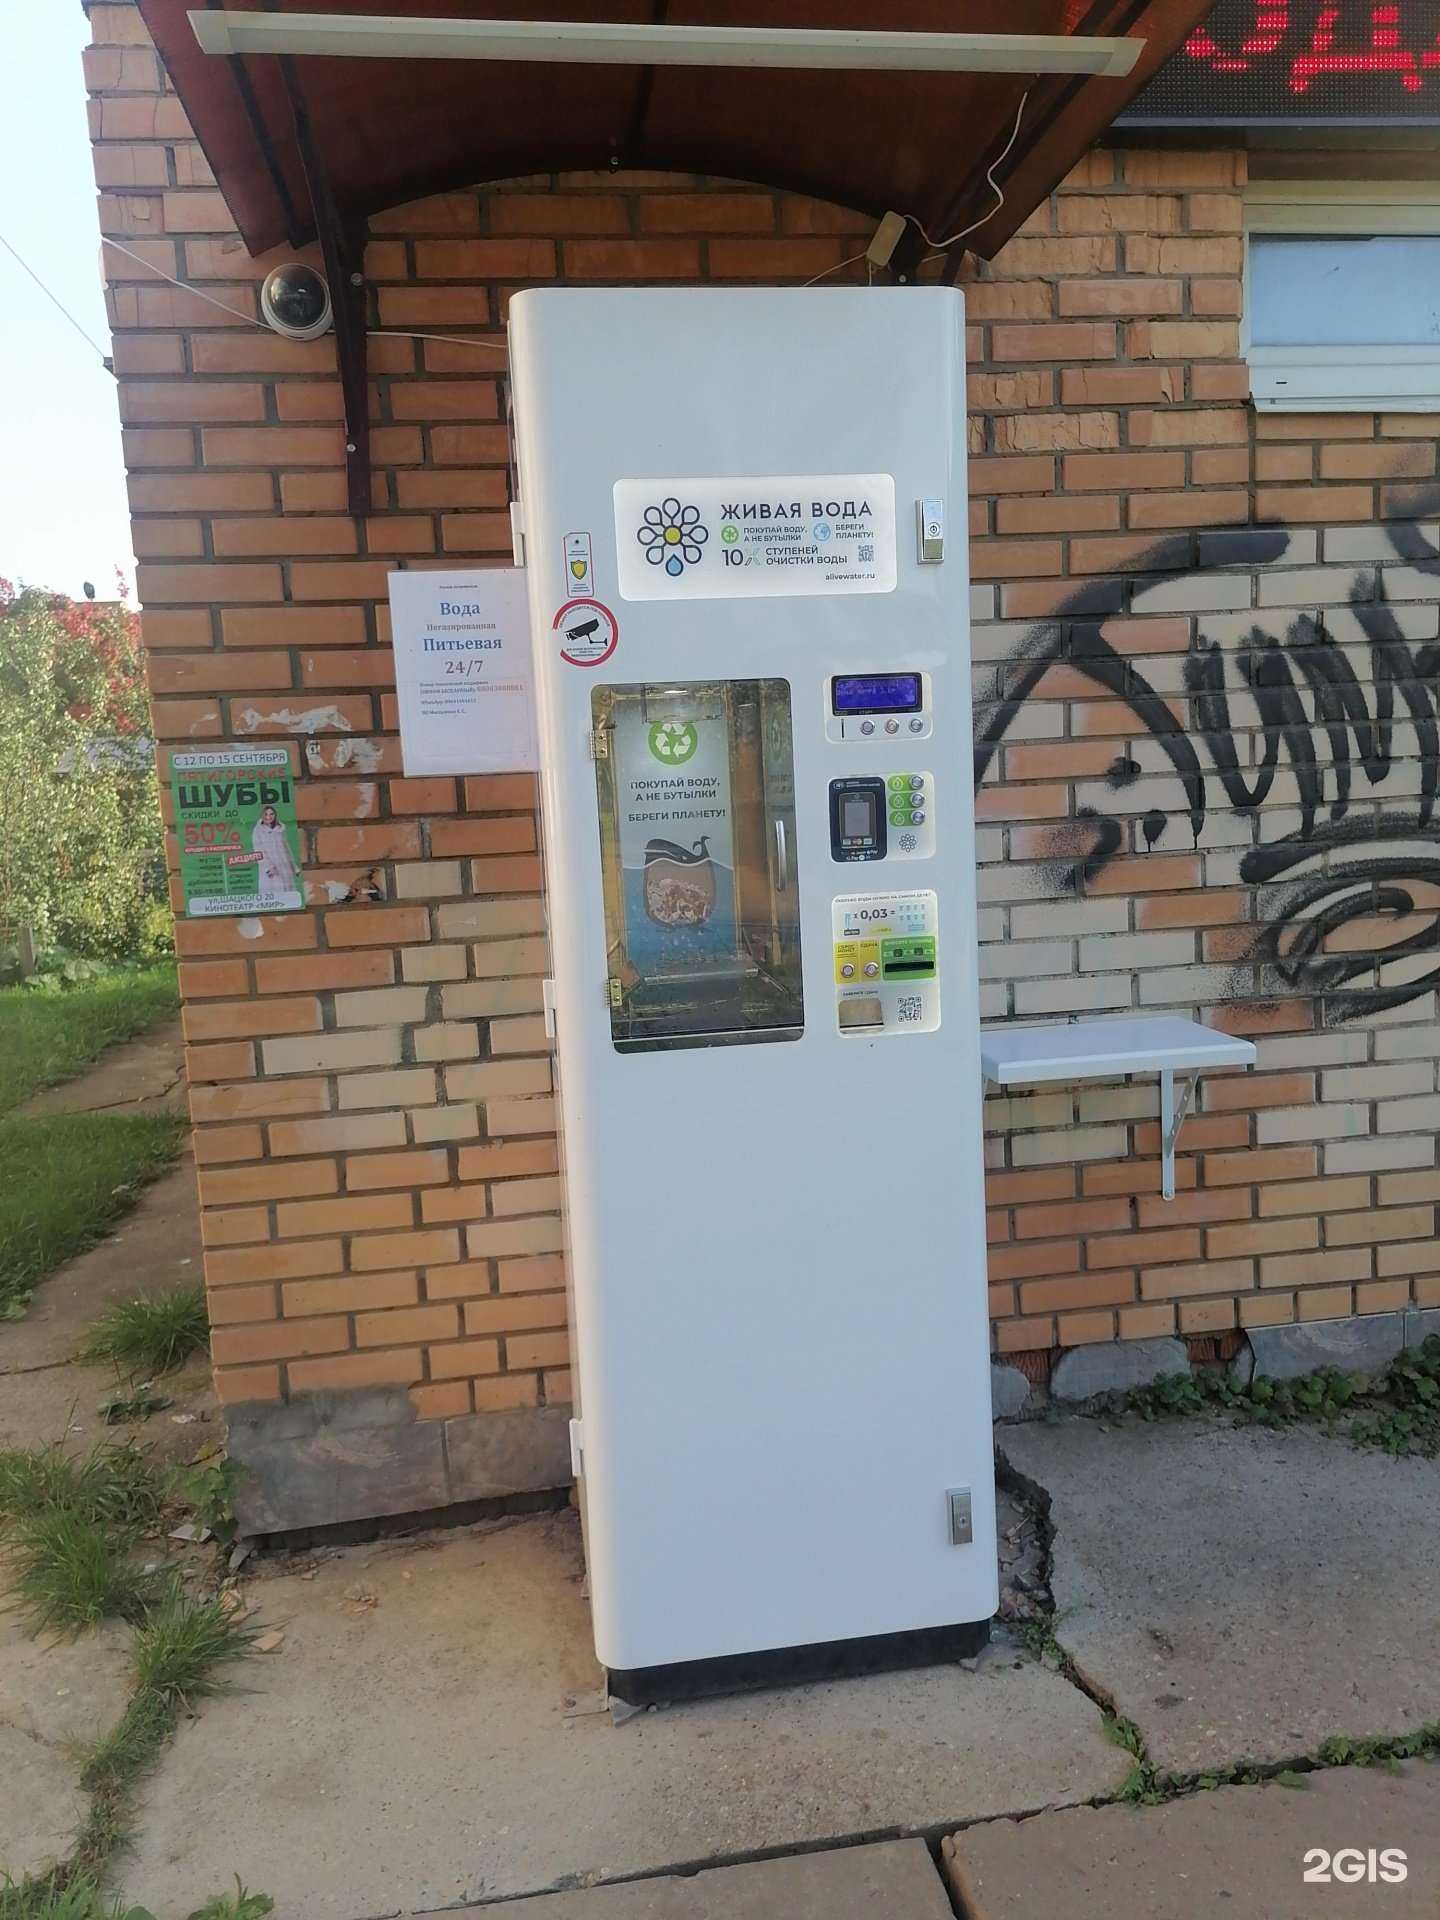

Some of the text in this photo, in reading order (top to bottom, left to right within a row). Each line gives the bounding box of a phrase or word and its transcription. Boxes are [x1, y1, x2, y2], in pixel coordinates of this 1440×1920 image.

[721, 501, 873, 520] ЖИВАЯ ВОДА
[743, 526, 783, 535] ПОКУПАЙ
[835, 531, 874, 540] ПЛАНЕТУ!
[763, 534, 802, 542] БУТЫЛКИ
[765, 545, 819, 556] СТУПЕНЕЙ
[766, 555, 848, 566] ОЧИСТКИ ВОДЫ
[825, 572, 876, 581] alivewater.ru
[439, 602, 481, 617] Вода
[423, 637, 504, 652] Питьевая
[444, 660, 484, 677] 24/7
[199, 755, 215, 765] ПО
[219, 754, 231, 764] 15
[232, 752, 286, 764] СЕНТЯБРЯ
[630, 776, 721, 790] ПОКУПАЙ ВОДУ,
[178, 781, 291, 809] ШУБЫ
[635, 789, 717, 802] А НЕ БУТЫЛКИ
[181, 809, 239, 820] СКИДКИ ДО
[628, 808, 727, 822] БЕРЕГИ ПЛАНЕТУ!
[184, 822, 242, 845] 50%
[204, 903, 254, 913] КИНОТЕАТР
[860, 909, 888, 921] 0,03
